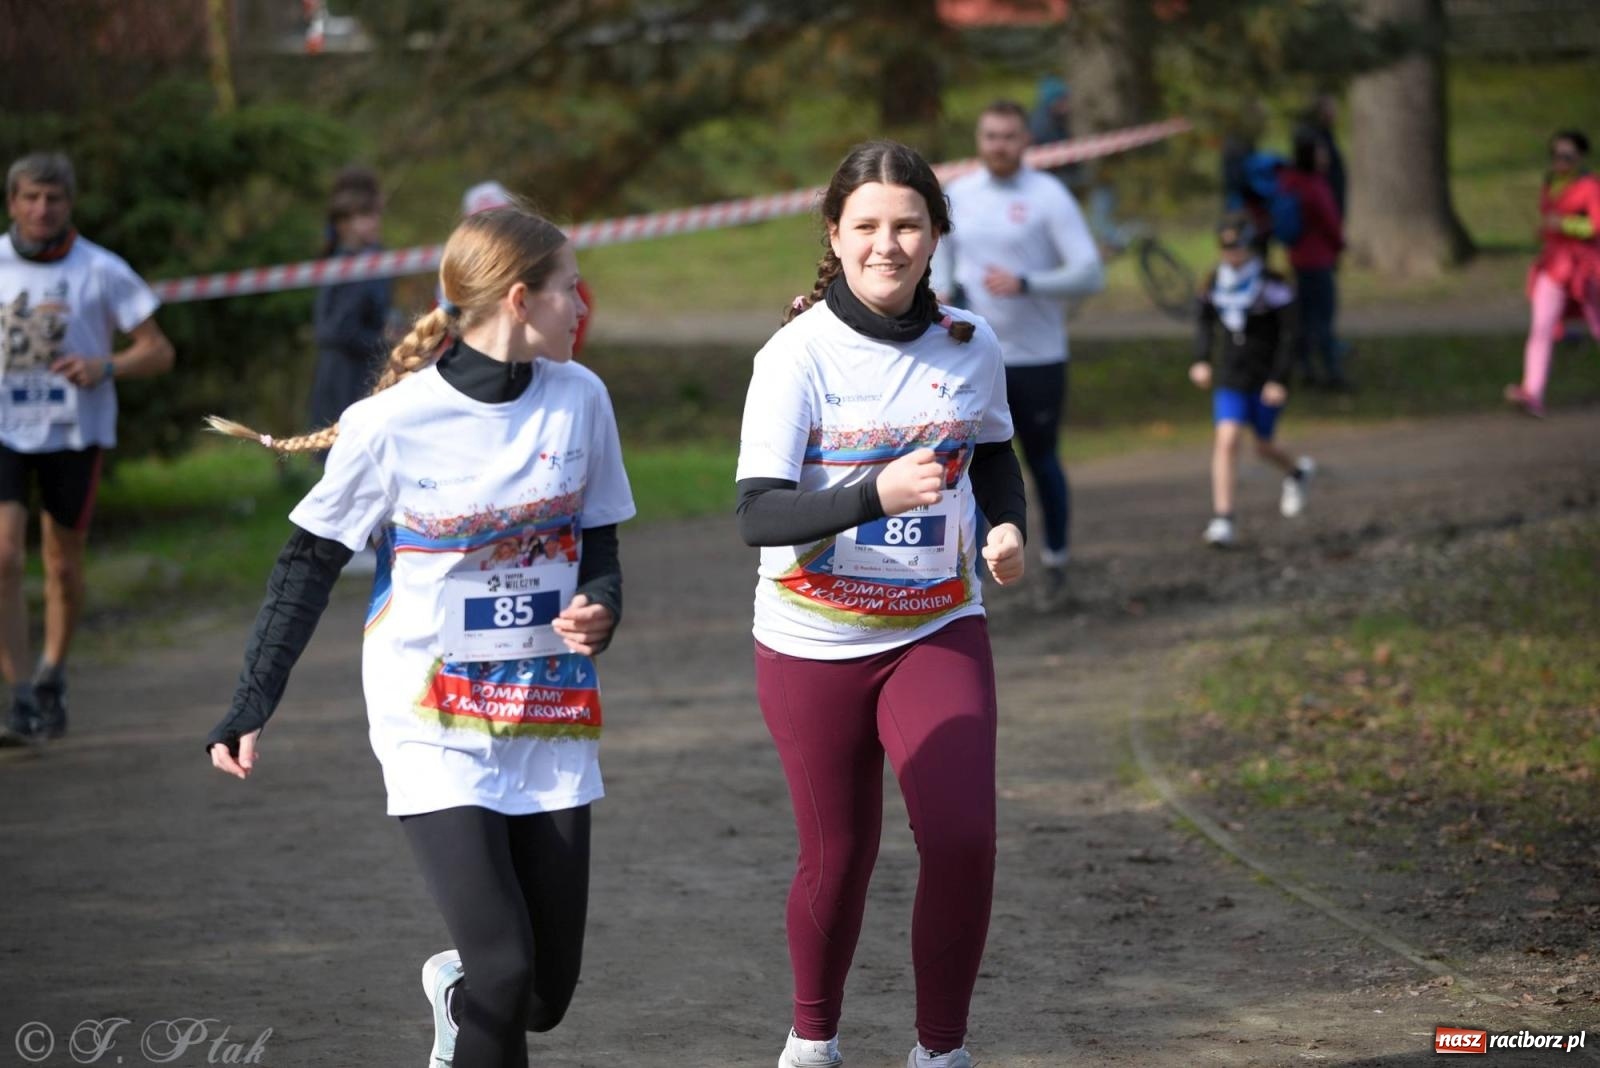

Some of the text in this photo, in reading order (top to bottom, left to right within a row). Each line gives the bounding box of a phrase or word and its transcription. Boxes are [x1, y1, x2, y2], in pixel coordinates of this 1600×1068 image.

[883, 517, 922, 545] 86
[505, 577, 541, 589] WILCZYM
[795, 582, 953, 611] Z KAŻDYM KROKIEM
[493, 595, 534, 627] 85
[441, 693, 592, 720] Z KAŻDYM KROKIEM
[472, 684, 564, 702] POMAGAMY
